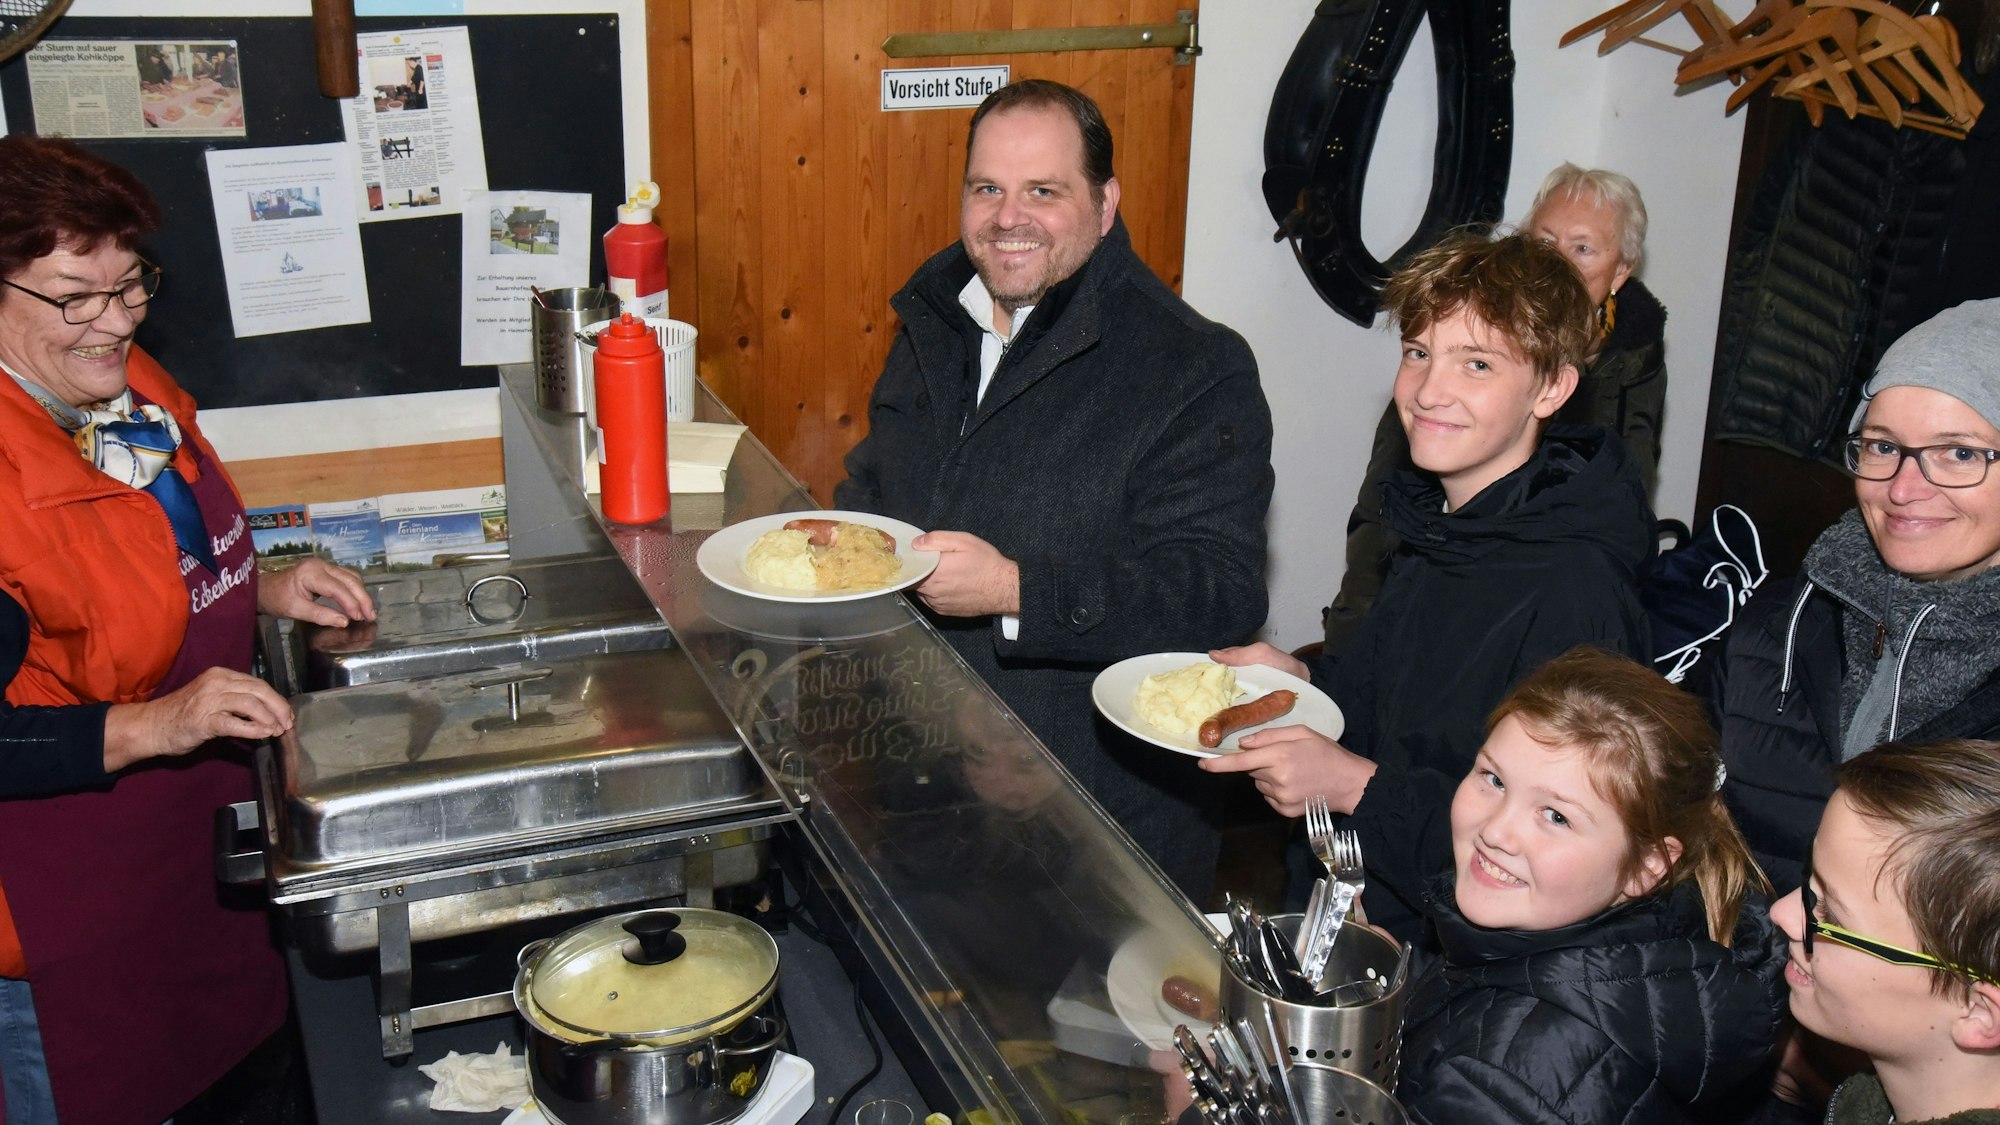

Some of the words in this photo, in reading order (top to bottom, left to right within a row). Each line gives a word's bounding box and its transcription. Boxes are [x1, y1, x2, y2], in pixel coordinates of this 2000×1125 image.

[76, 43, 90, 51] auf
[28, 53, 75, 62] eingelegte
[77, 52, 125, 62] Kohlköppe
[889, 78, 950, 99] Vorsicht
[955, 76, 993, 96] Stufe
[647, 302, 662, 314] Senf
[397, 520, 439, 535] Ferienland
[191, 551, 256, 614] Eckenhagen
